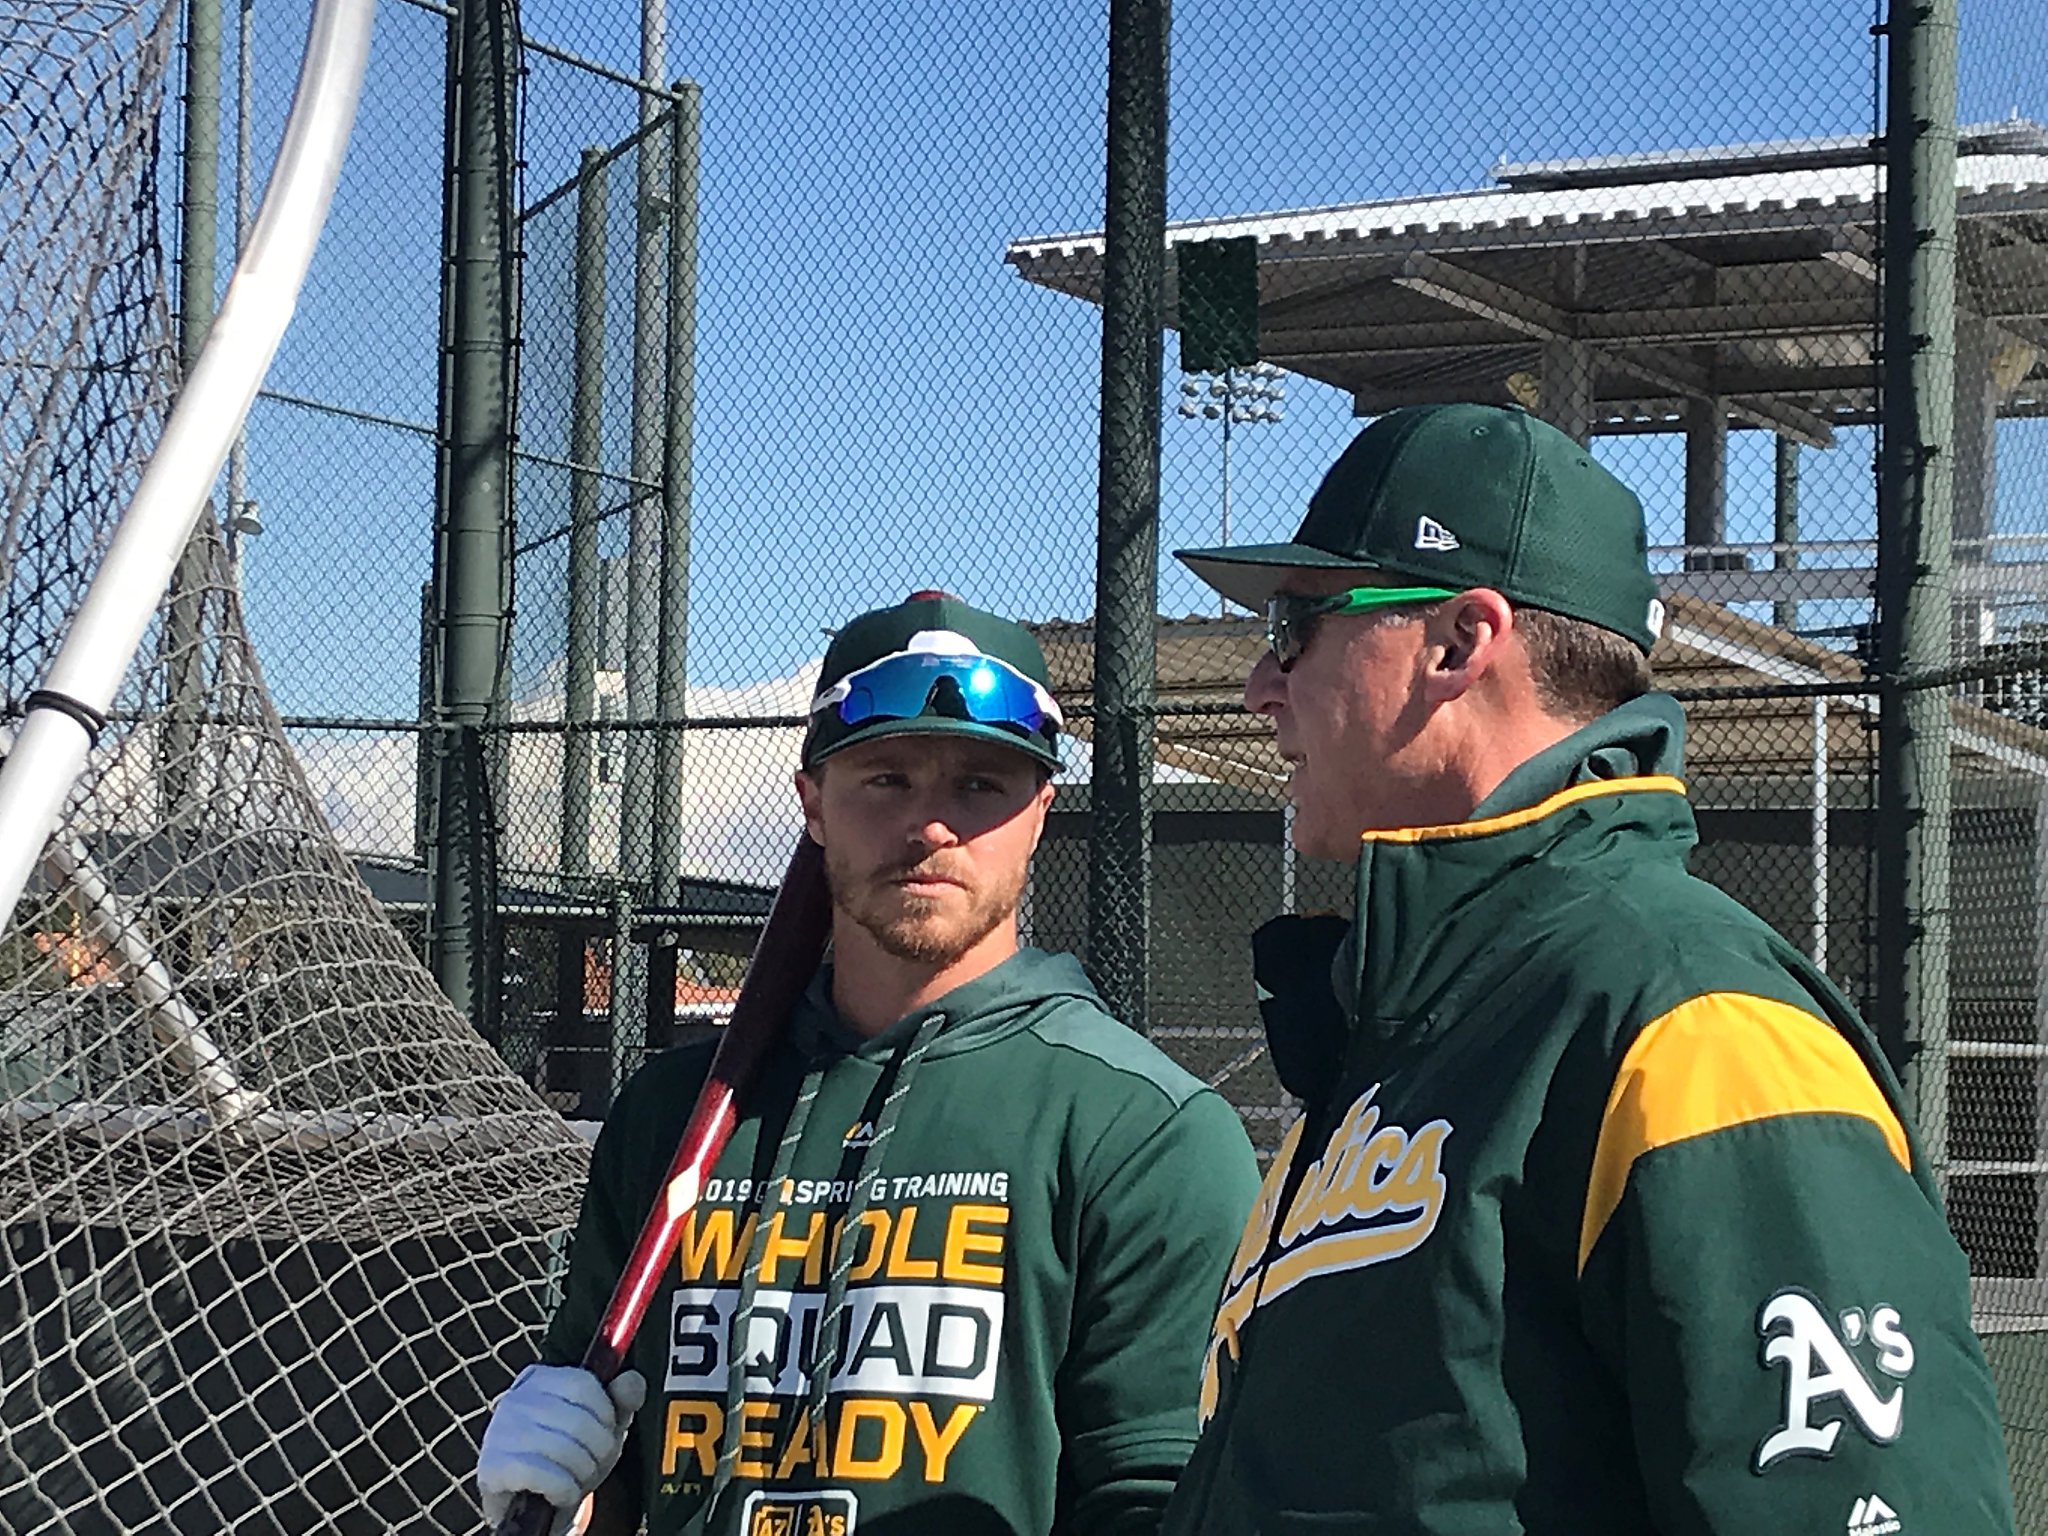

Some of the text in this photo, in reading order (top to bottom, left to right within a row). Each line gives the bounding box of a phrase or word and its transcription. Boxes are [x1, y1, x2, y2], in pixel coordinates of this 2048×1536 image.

[698, 1171, 1009, 1205] 019 SPRIG TRAINING
[680, 1205, 1010, 1286] WHOLE
[671, 1301, 992, 1387] SQUAD
[1755, 1289, 1915, 1472] A's
[661, 1400, 978, 1483] READY
